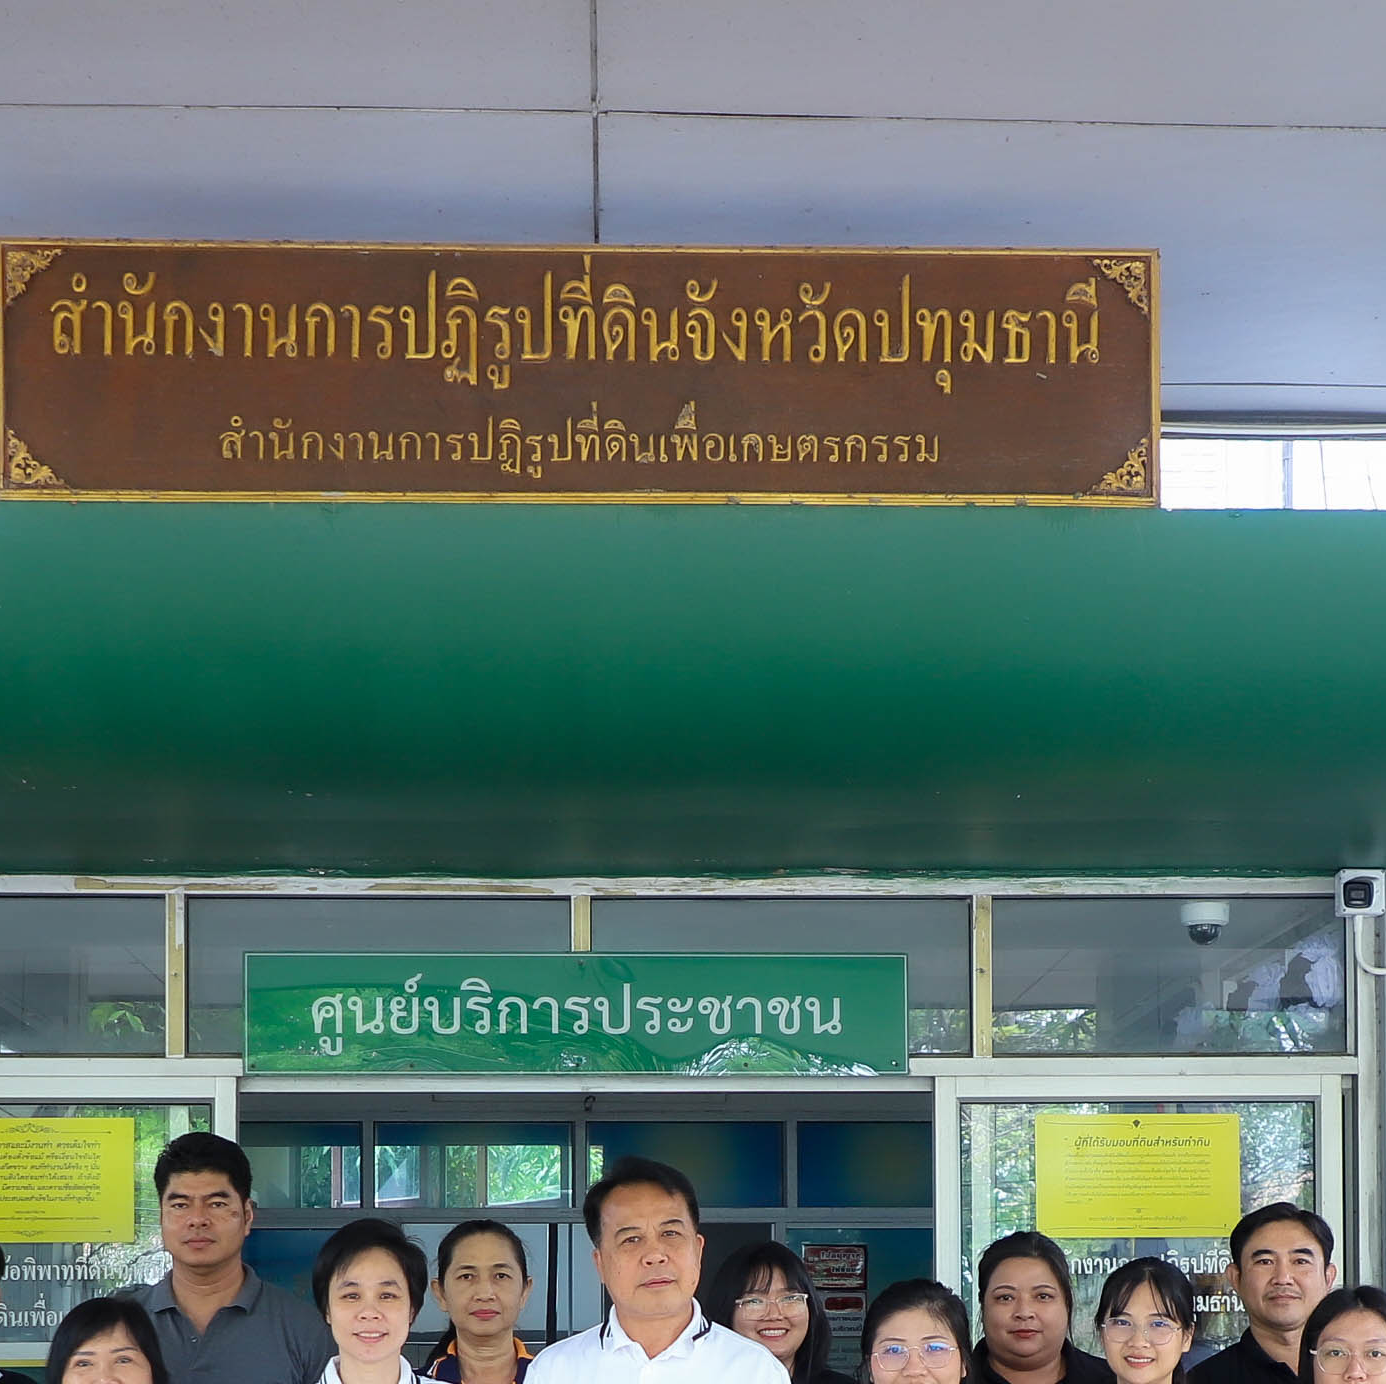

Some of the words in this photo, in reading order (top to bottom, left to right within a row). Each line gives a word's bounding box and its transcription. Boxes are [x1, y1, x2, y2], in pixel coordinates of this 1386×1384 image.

[50, 254, 1100, 394] สำนักงานการปฏิรูปที่ดินจังหวัดปทุมธานี
[219, 402, 941, 479] สำนักงานการปฏิรูปที่ดินเพื่อเกษตรกรรม
[311, 973, 843, 1056] ศูนย์บริการประชาชน
